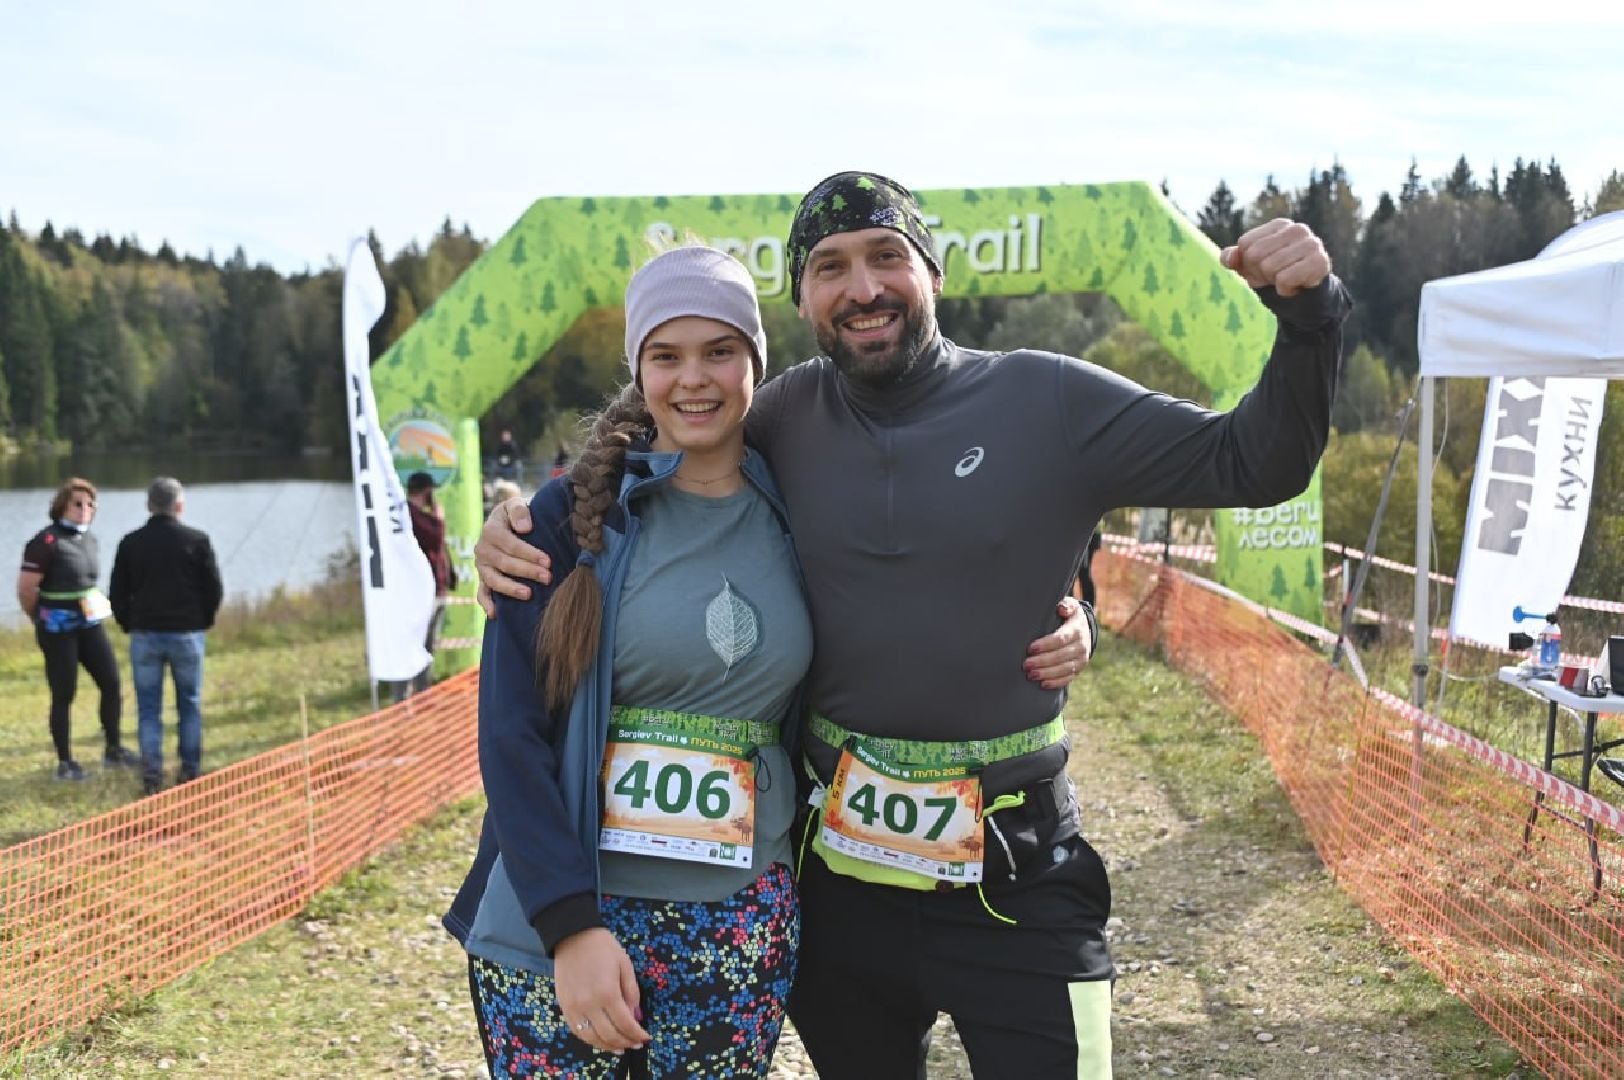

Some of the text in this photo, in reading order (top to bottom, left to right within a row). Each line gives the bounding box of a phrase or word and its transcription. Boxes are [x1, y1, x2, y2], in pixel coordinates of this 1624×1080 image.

[924, 213, 1041, 273] rail
[618, 729, 652, 740] Sergiev
[654, 732, 679, 743] Trail
[614, 760, 731, 820] 406
[942, 767, 967, 777] 2025
[847, 783, 957, 842] 407
